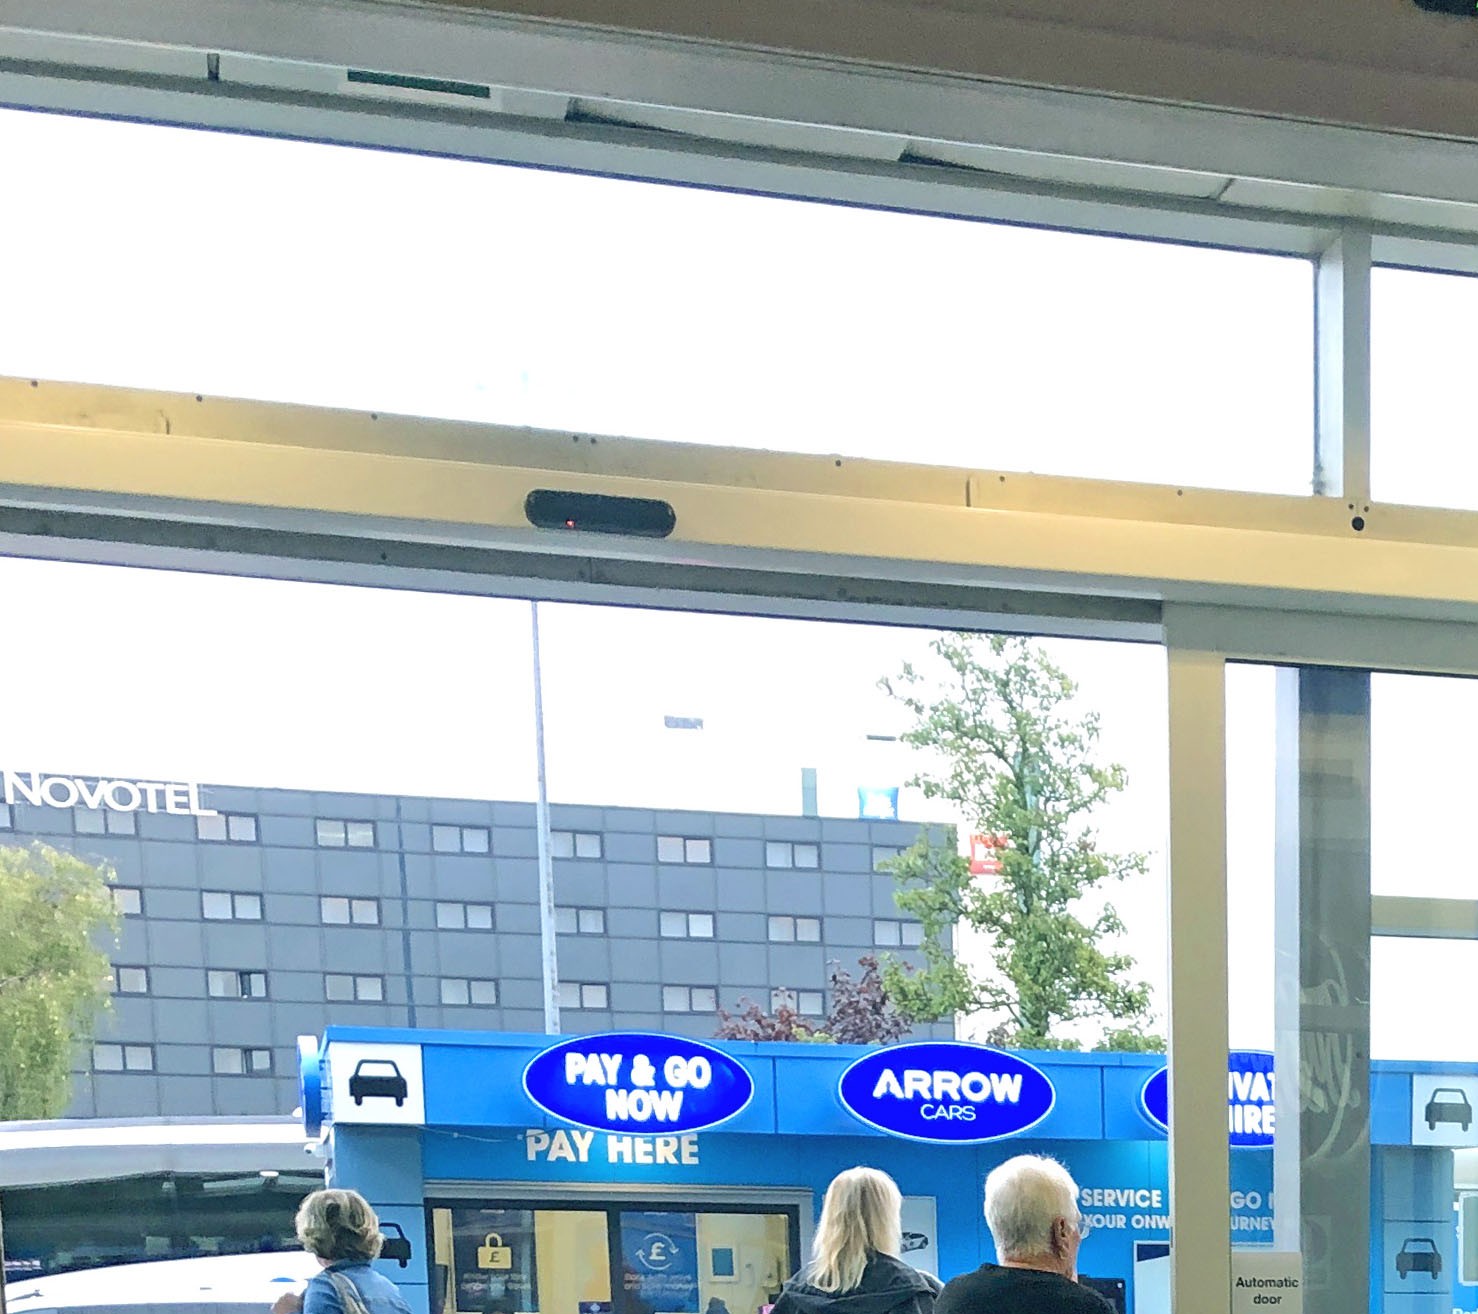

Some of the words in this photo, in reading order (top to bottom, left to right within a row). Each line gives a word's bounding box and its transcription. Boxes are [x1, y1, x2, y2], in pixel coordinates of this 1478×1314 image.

[4, 771, 217, 816] NOVOTEL
[565, 1052, 622, 1086] PAY
[630, 1054, 655, 1088] &
[663, 1055, 712, 1089] GO
[872, 1068, 1023, 1104] ARROW
[1228, 1071, 1275, 1102] IVAT
[605, 1088, 683, 1121] NOW
[920, 1103, 977, 1121] CARS
[526, 1129, 594, 1163] PAY
[607, 1132, 700, 1165] HERE
[1080, 1188, 1163, 1209] SERVICE
[1230, 1191, 1262, 1209] GO
[1131, 1214, 1170, 1229] ONW
[1231, 1216, 1274, 1230] URNE
[1236, 1277, 1299, 1288] Automatic
[1253, 1294, 1282, 1304] door
